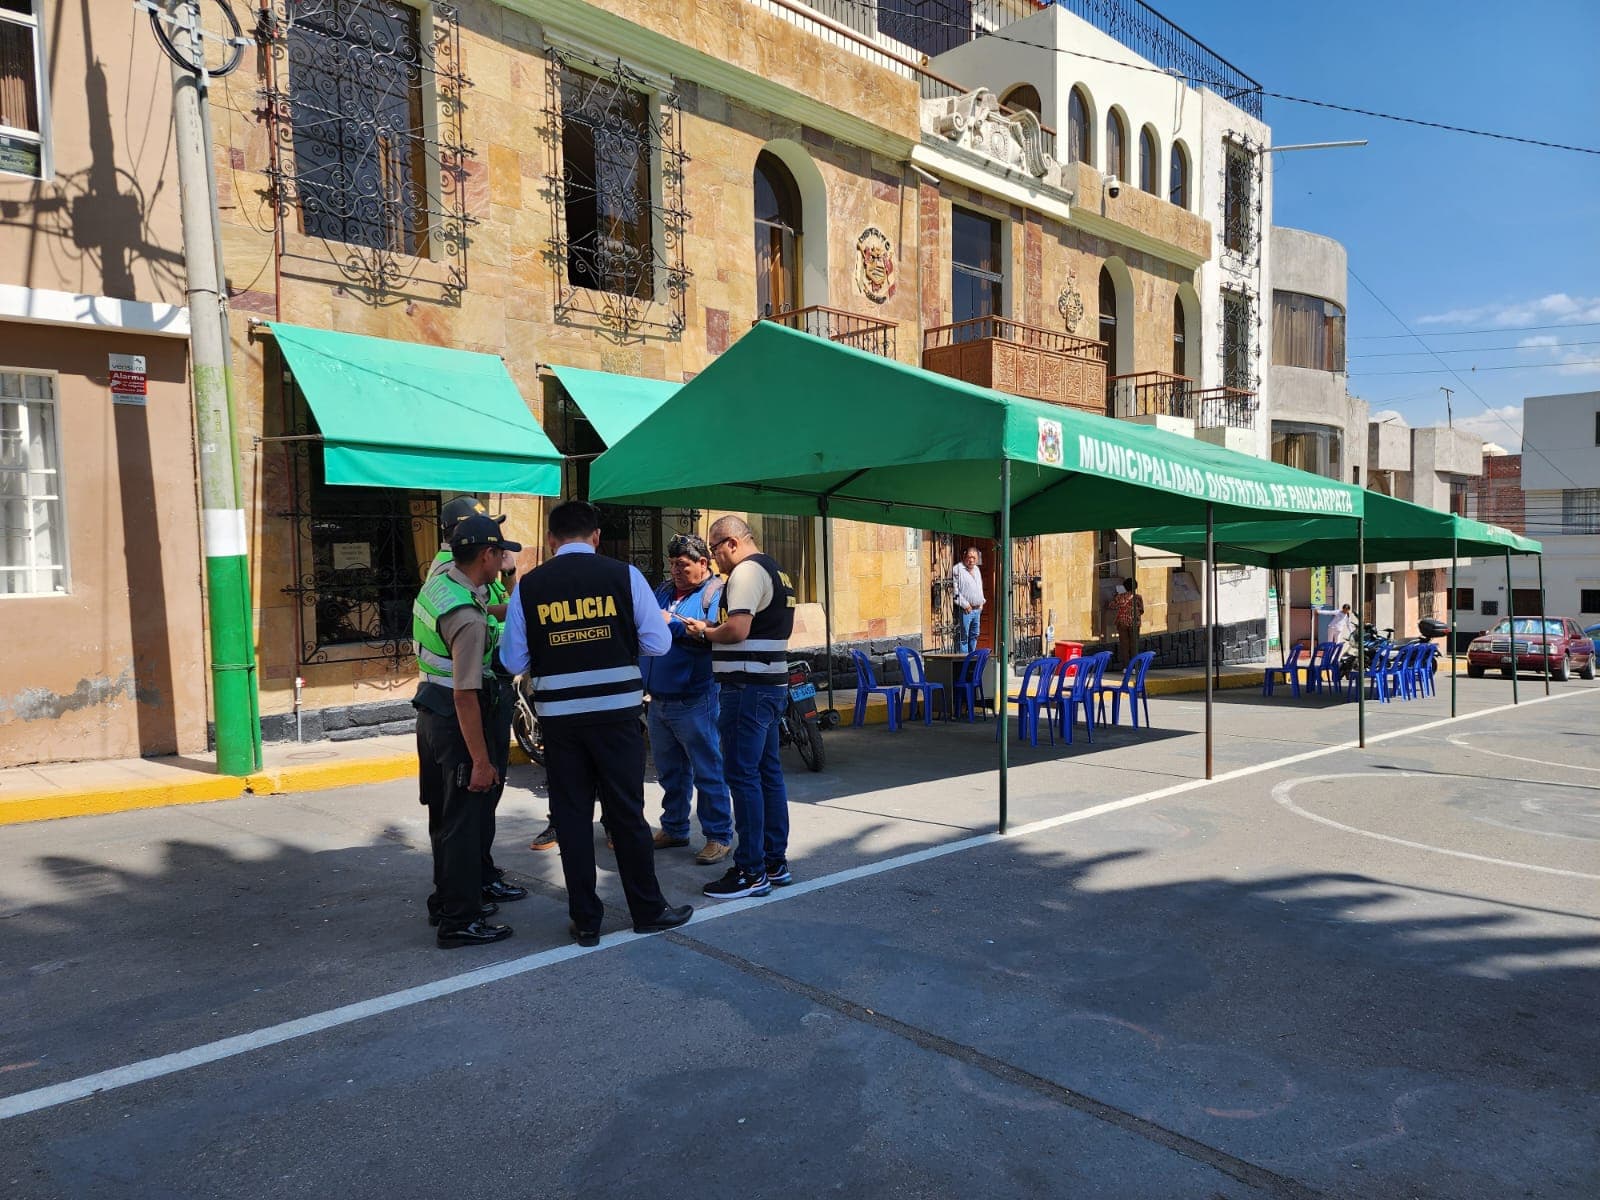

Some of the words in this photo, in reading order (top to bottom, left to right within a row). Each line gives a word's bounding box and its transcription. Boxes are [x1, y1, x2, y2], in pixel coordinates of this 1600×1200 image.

[113, 372, 145, 381] Alarma
[1078, 434, 1205, 496] MUNICIPALIDAD
[1205, 471, 1272, 507] DISTRITAL
[1270, 483, 1289, 509] DE
[1287, 485, 1353, 513] PAUCARPATA
[552, 628, 608, 644] DEPINCRI
